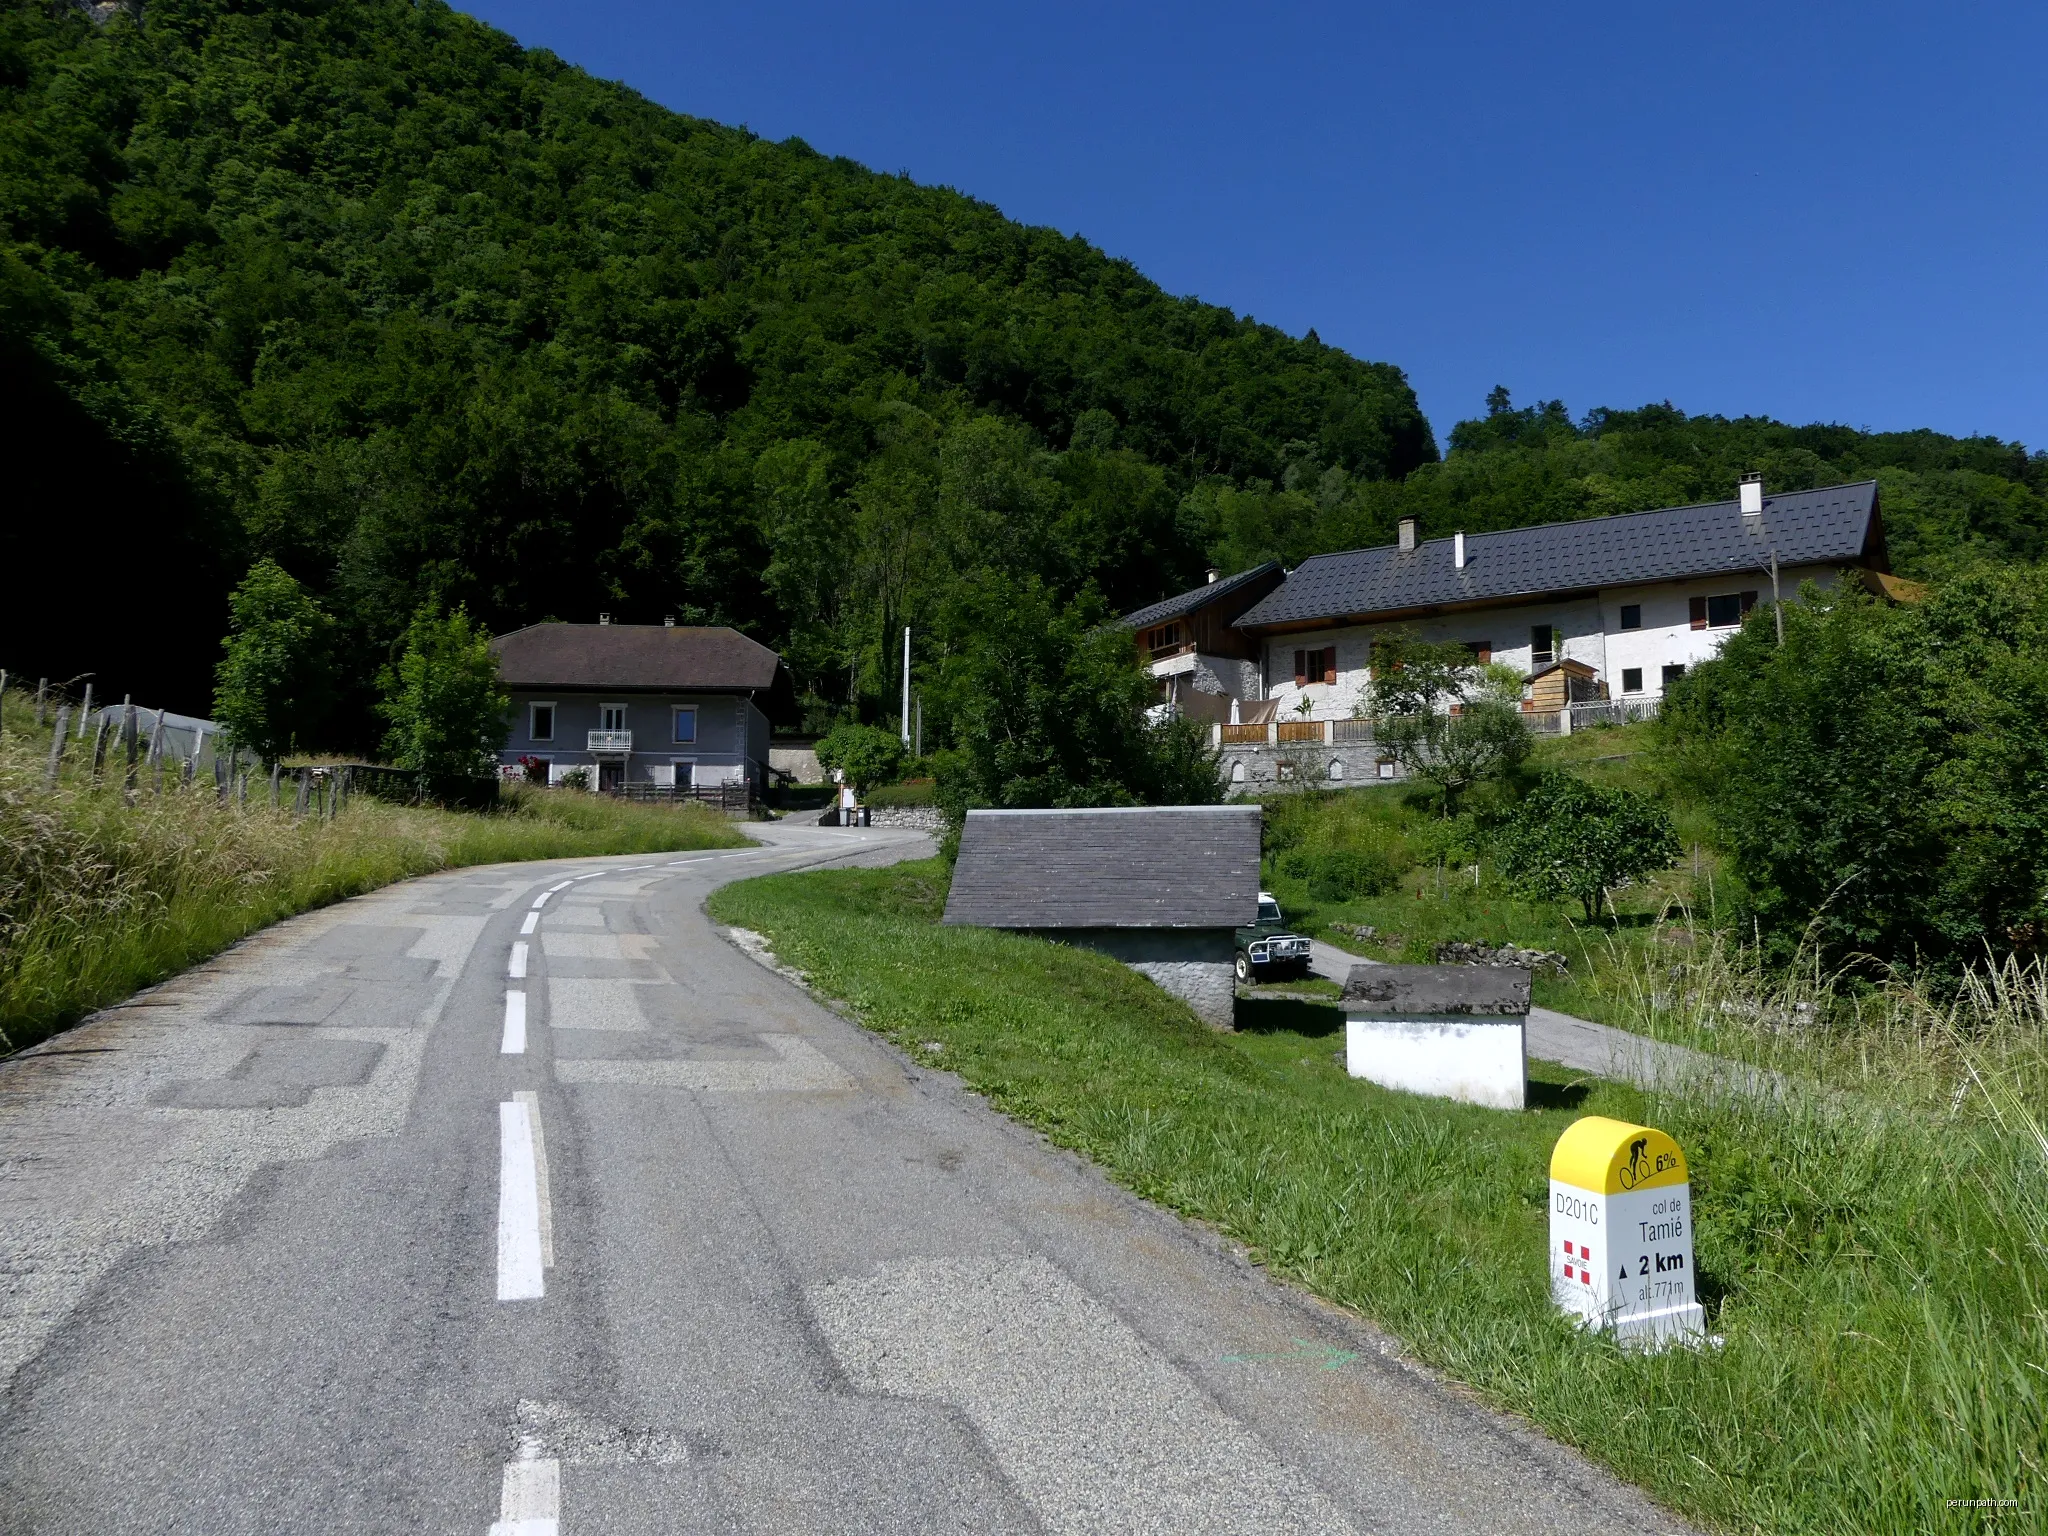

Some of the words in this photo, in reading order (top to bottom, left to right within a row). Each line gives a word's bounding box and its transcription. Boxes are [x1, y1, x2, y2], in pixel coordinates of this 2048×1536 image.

[1655, 1151, 1677, 1172] 6%
[1556, 1193, 1598, 1225] D201C
[1652, 1200, 1667, 1215] col
[1669, 1198, 1681, 1213] de
[1639, 1216, 1682, 1243] Tamié
[1566, 1255, 1588, 1270] SAVOIE
[1639, 1255, 1649, 1276] 2
[1656, 1252, 1684, 1273] km
